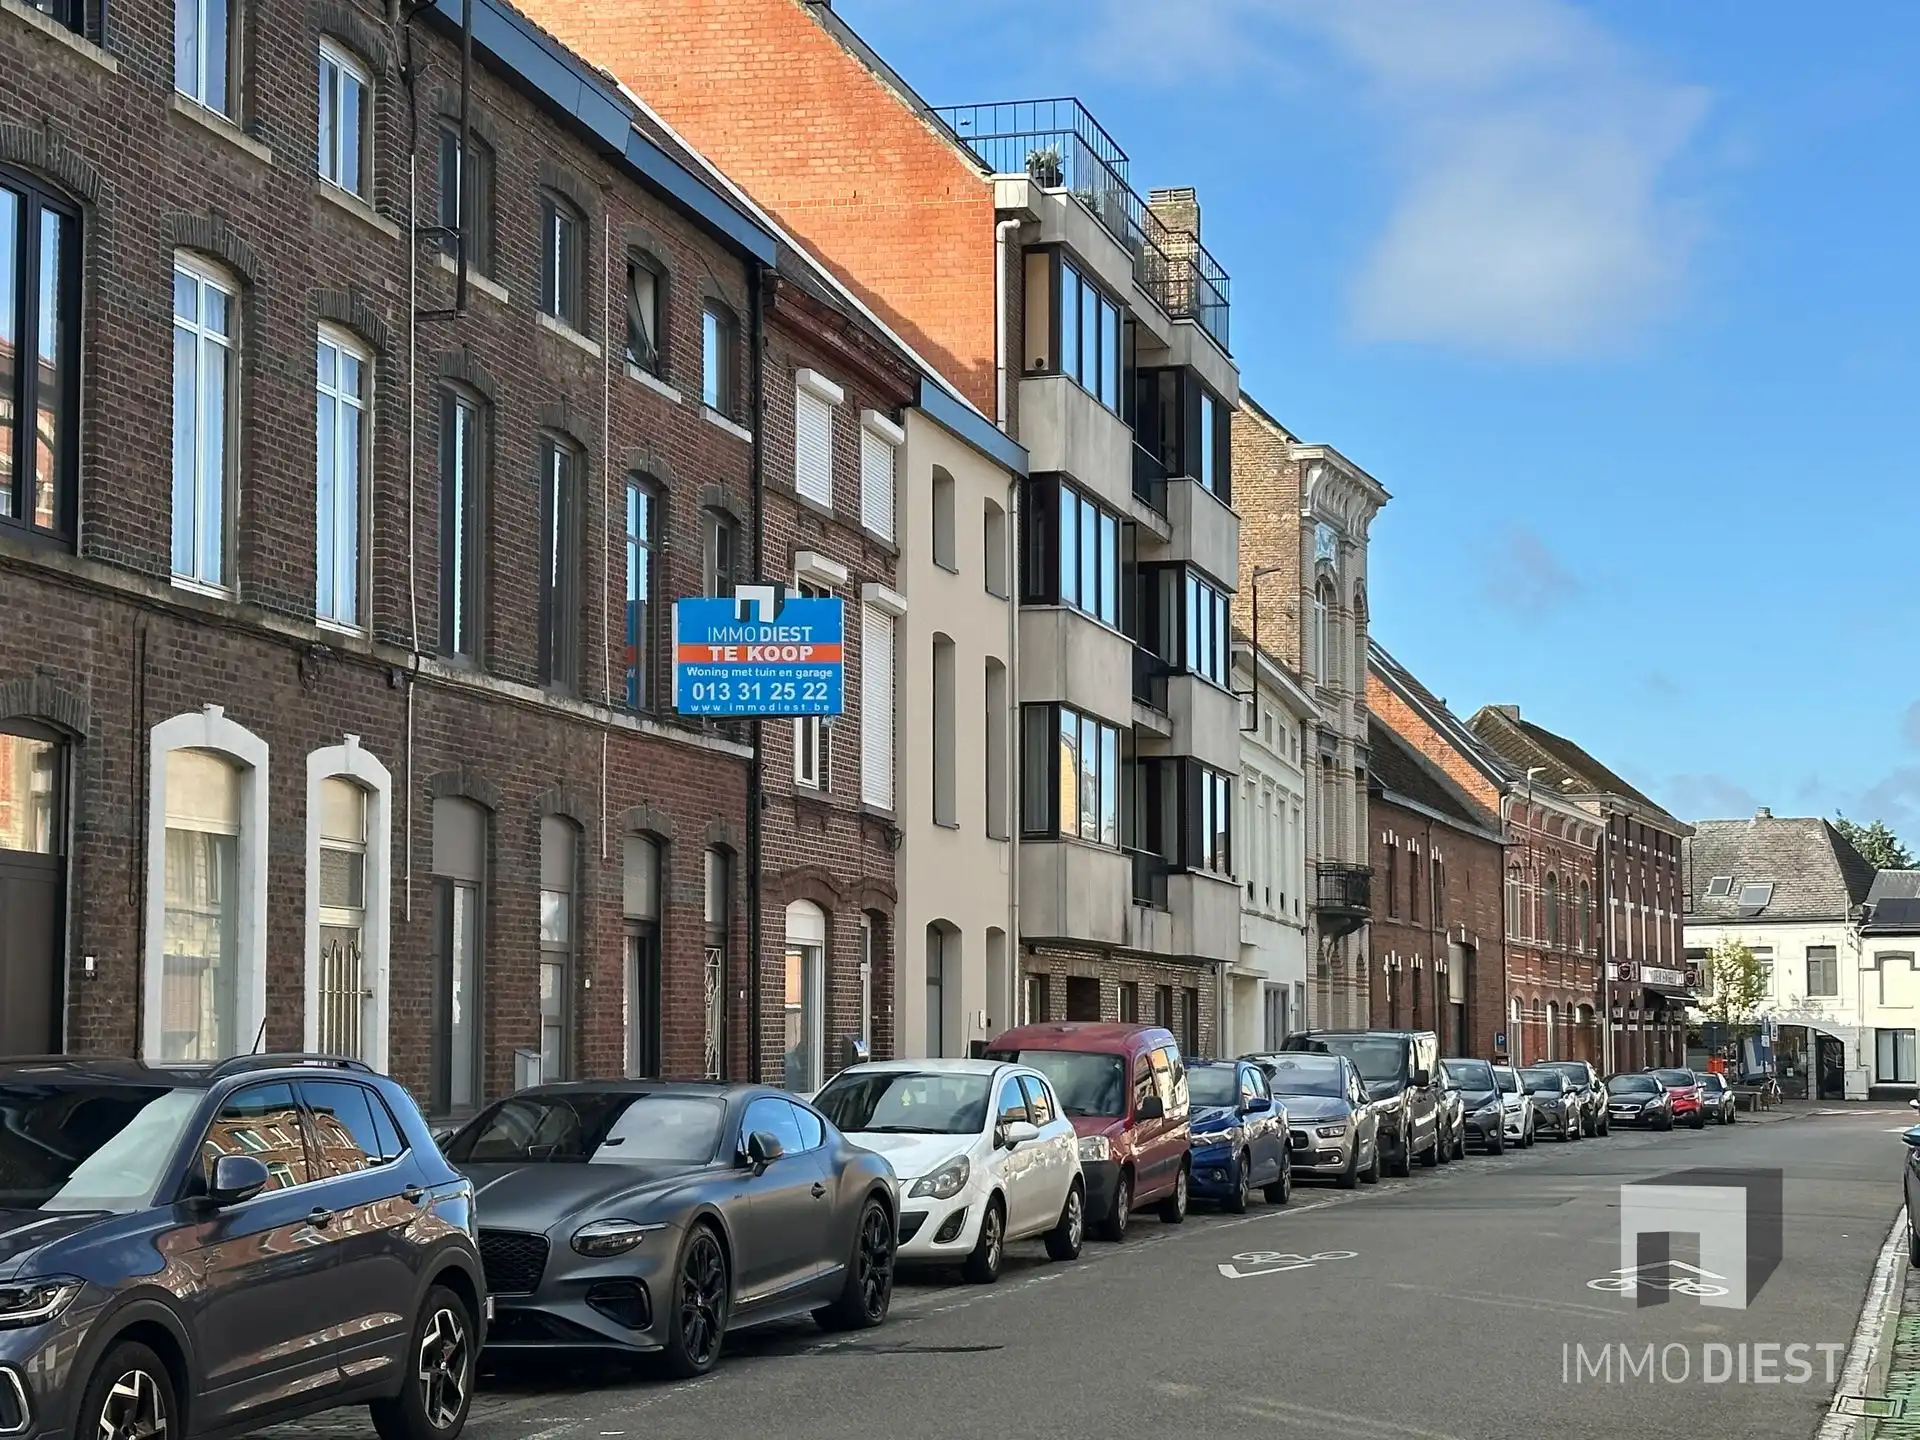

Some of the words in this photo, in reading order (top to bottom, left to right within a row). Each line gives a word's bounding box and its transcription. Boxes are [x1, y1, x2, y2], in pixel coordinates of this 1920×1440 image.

[707, 626, 756, 642] IMMO
[759, 626, 813, 642] DIEST
[707, 645, 738, 661] TE
[747, 645, 813, 661] KOOP
[687, 667, 728, 678] Woning
[731, 668, 752, 677] met
[755, 668, 776, 677] tuin
[779, 669, 792, 677] en
[795, 670, 833, 679] garage
[692, 682, 730, 700] 013
[738, 682, 761, 700] 31
[770, 682, 796, 700] 25
[802, 682, 828, 700] 22
[1498, 1035, 1505, 1045] P
